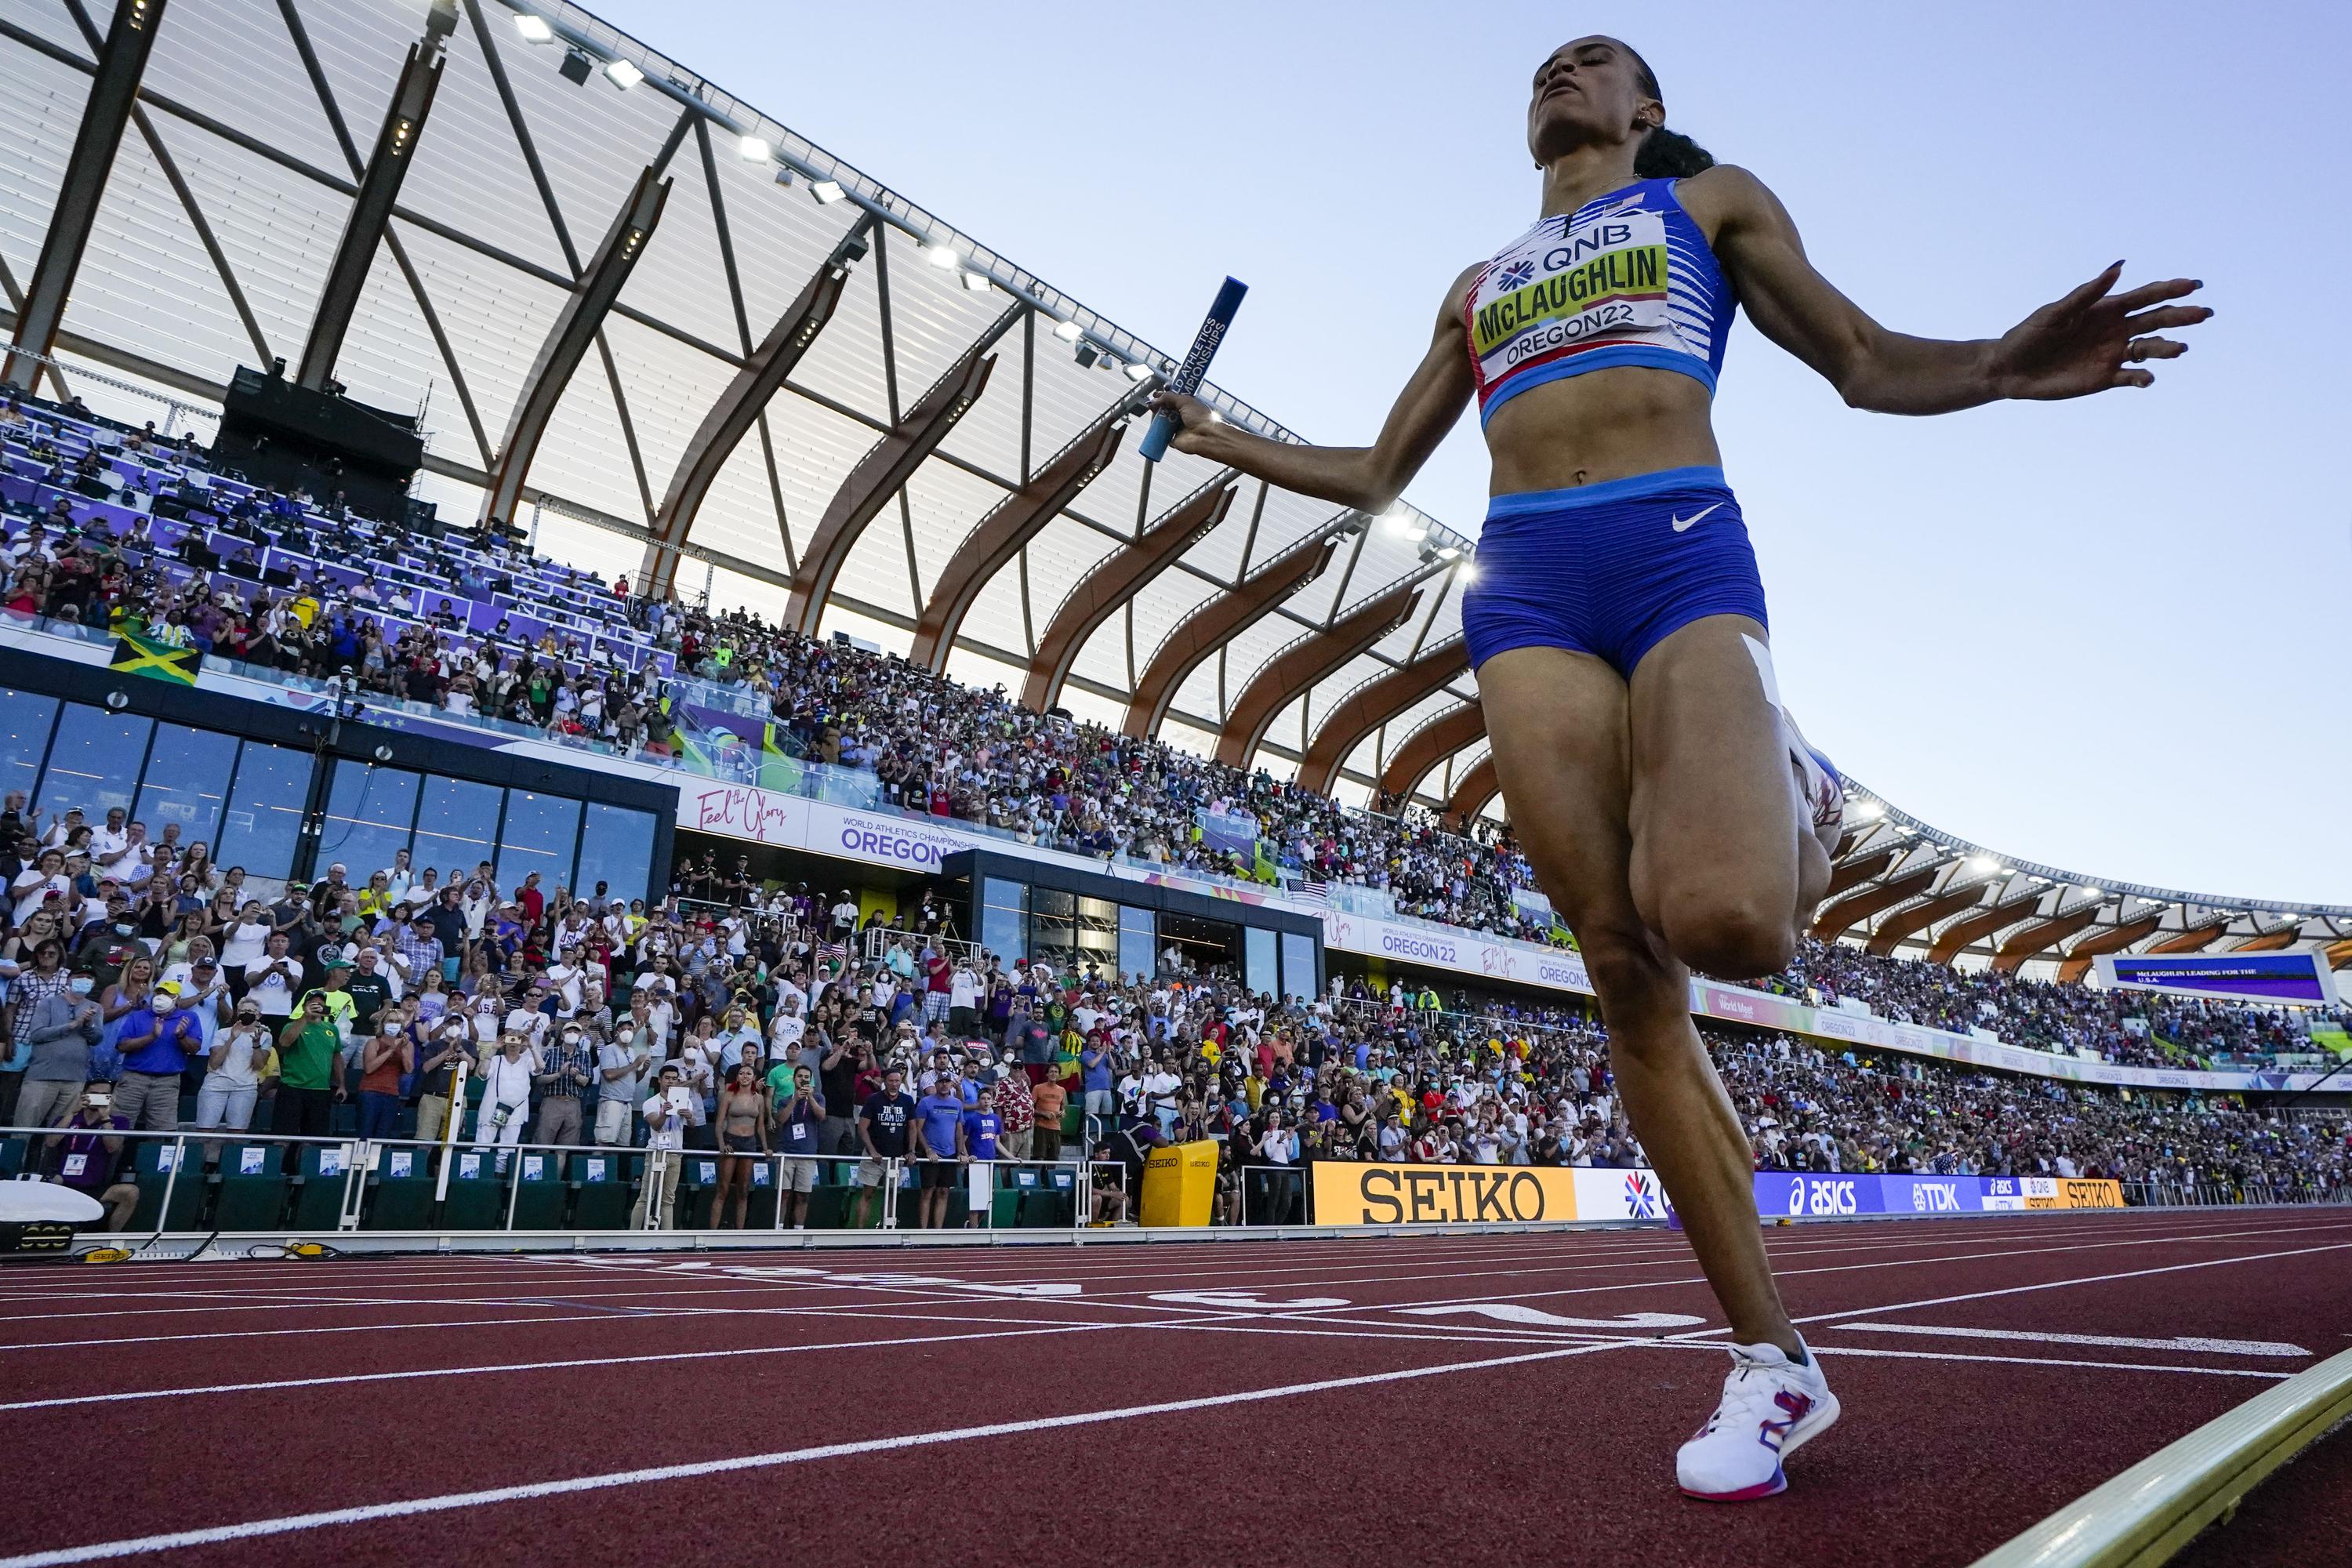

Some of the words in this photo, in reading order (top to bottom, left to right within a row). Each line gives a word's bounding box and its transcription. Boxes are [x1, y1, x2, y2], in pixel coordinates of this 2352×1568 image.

[1543, 224, 1632, 272] QNB
[1181, 318, 1216, 379] ATHLETICS
[1507, 304, 1634, 365] OREGON22
[697, 789, 735, 830] Feel
[732, 789, 745, 805] the
[744, 789, 786, 841] Glory
[841, 828, 961, 865] OREGON
[844, 817, 873, 829] WORLD
[875, 823, 917, 839] ATHLETICS
[920, 833, 980, 850] CHAMPIONSHIPS
[1149, 1158, 1178, 1169] SEIKO
[1360, 1168, 1545, 1224] SEIKO
[1810, 1181, 1857, 1215] asics
[1921, 1183, 1961, 1210] TDK
[1997, 1180, 2013, 1195] asics
[2067, 1181, 2115, 1209] SEIKO
[2029, 1197, 2056, 1209] SEIKO
[943, 1283, 1082, 1294] 4
[1147, 1291, 1352, 1308] 3
[1388, 1303, 1708, 1329] 2
